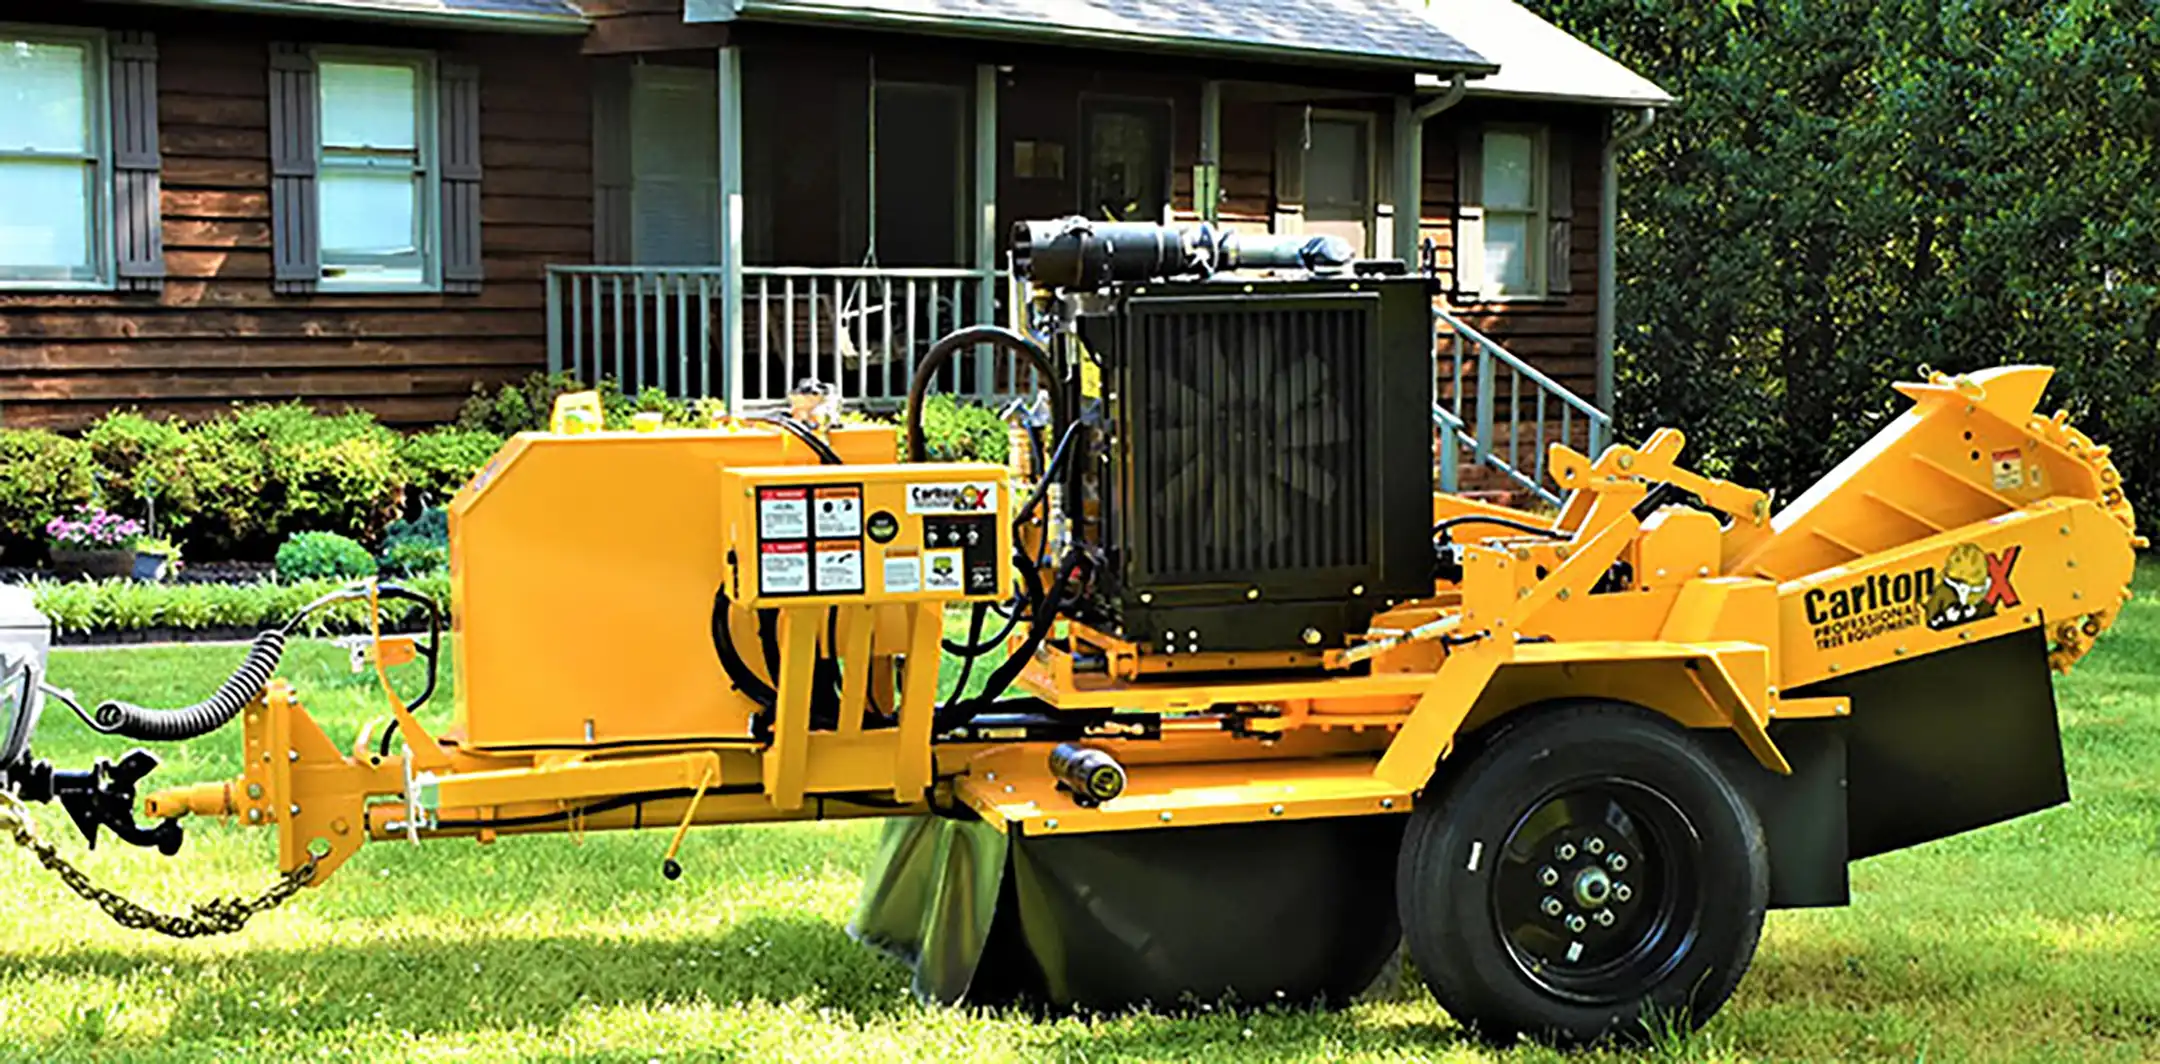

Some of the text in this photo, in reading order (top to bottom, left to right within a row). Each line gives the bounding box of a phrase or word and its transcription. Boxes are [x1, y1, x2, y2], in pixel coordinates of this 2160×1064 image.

[1804, 566, 1934, 625] Carlton
[1814, 602, 1920, 639] PROFESSIONAL
[1816, 614, 1920, 650] TREE EQUIPMENT
